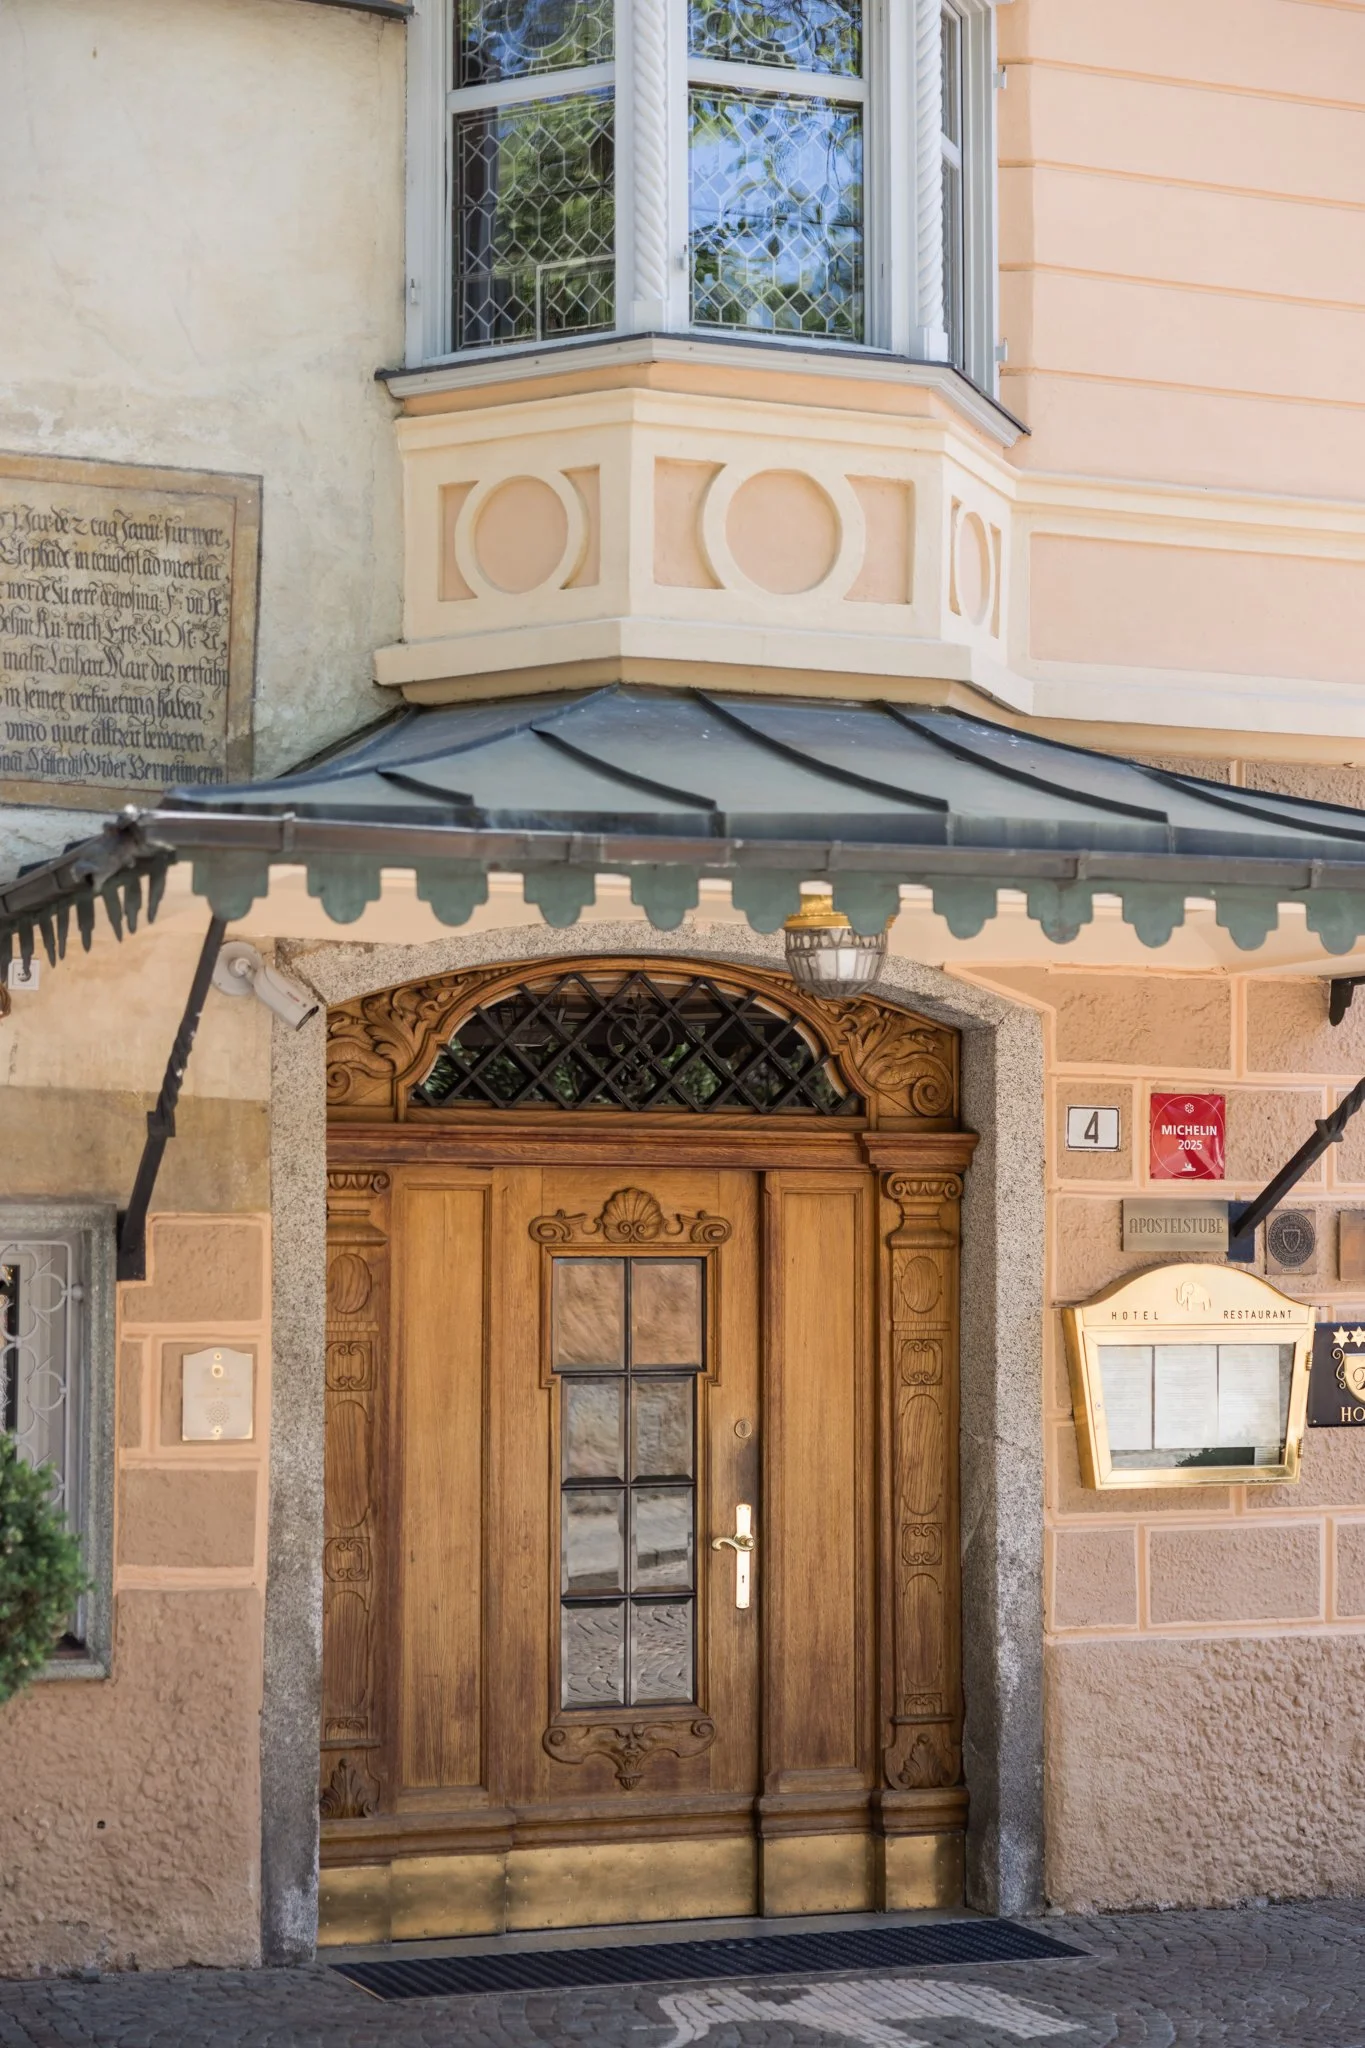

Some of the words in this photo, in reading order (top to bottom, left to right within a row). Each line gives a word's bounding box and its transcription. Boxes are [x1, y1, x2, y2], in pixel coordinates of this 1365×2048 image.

[1083, 1111, 1099, 1144] 4
[1161, 1124, 1218, 1136] MICHELIN
[1177, 1139, 1203, 1151] 2025
[1129, 1216, 1224, 1234] APOSTELSTUBE
[1111, 1310, 1159, 1321] HOTEL
[1223, 1309, 1293, 1320] RESTAURANT
